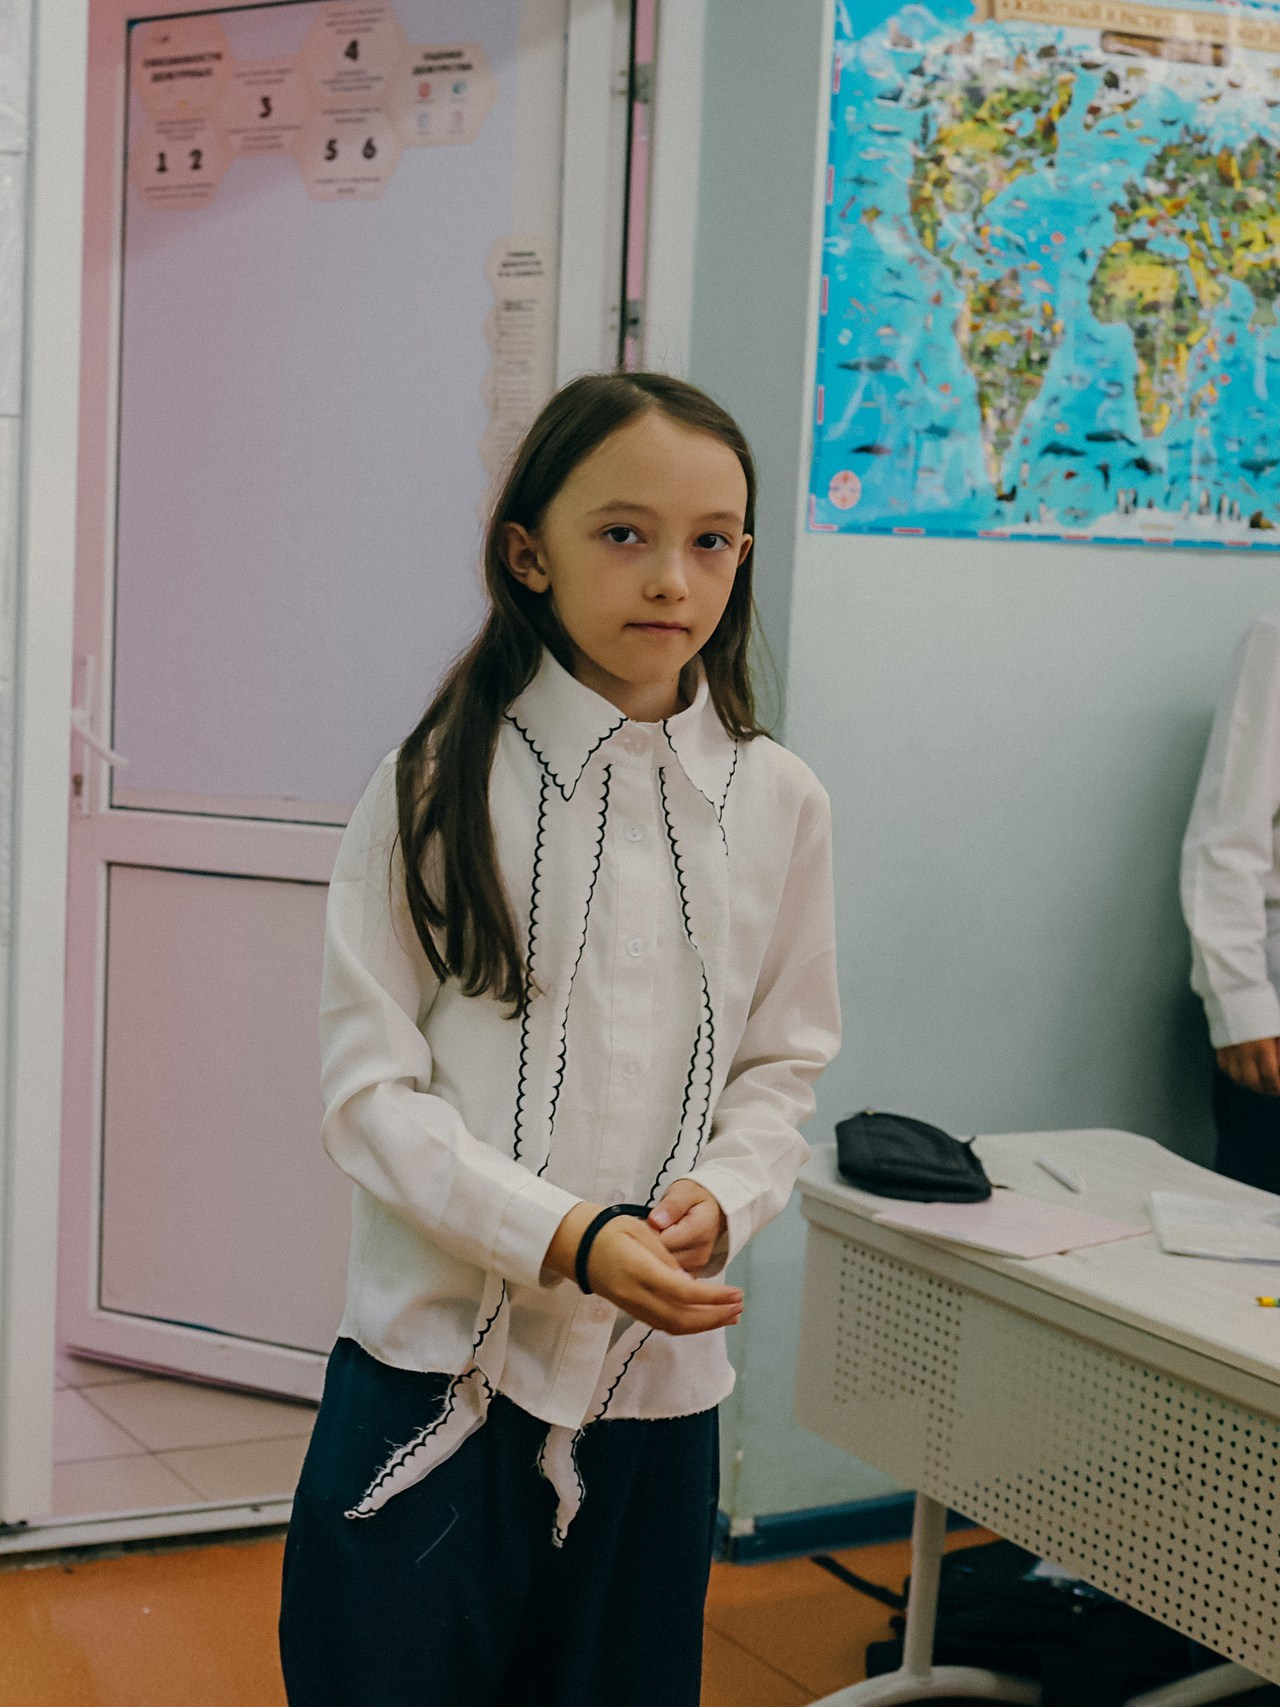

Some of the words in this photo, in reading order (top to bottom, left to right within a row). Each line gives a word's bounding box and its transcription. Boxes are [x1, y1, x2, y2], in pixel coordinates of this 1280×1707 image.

[344, 39, 359, 61] 4
[259, 96, 272, 119] 3
[324, 138, 338, 161] 5
[362, 137, 376, 160] 6
[155, 151, 168, 173] 1
[189, 149, 203, 170] 2
